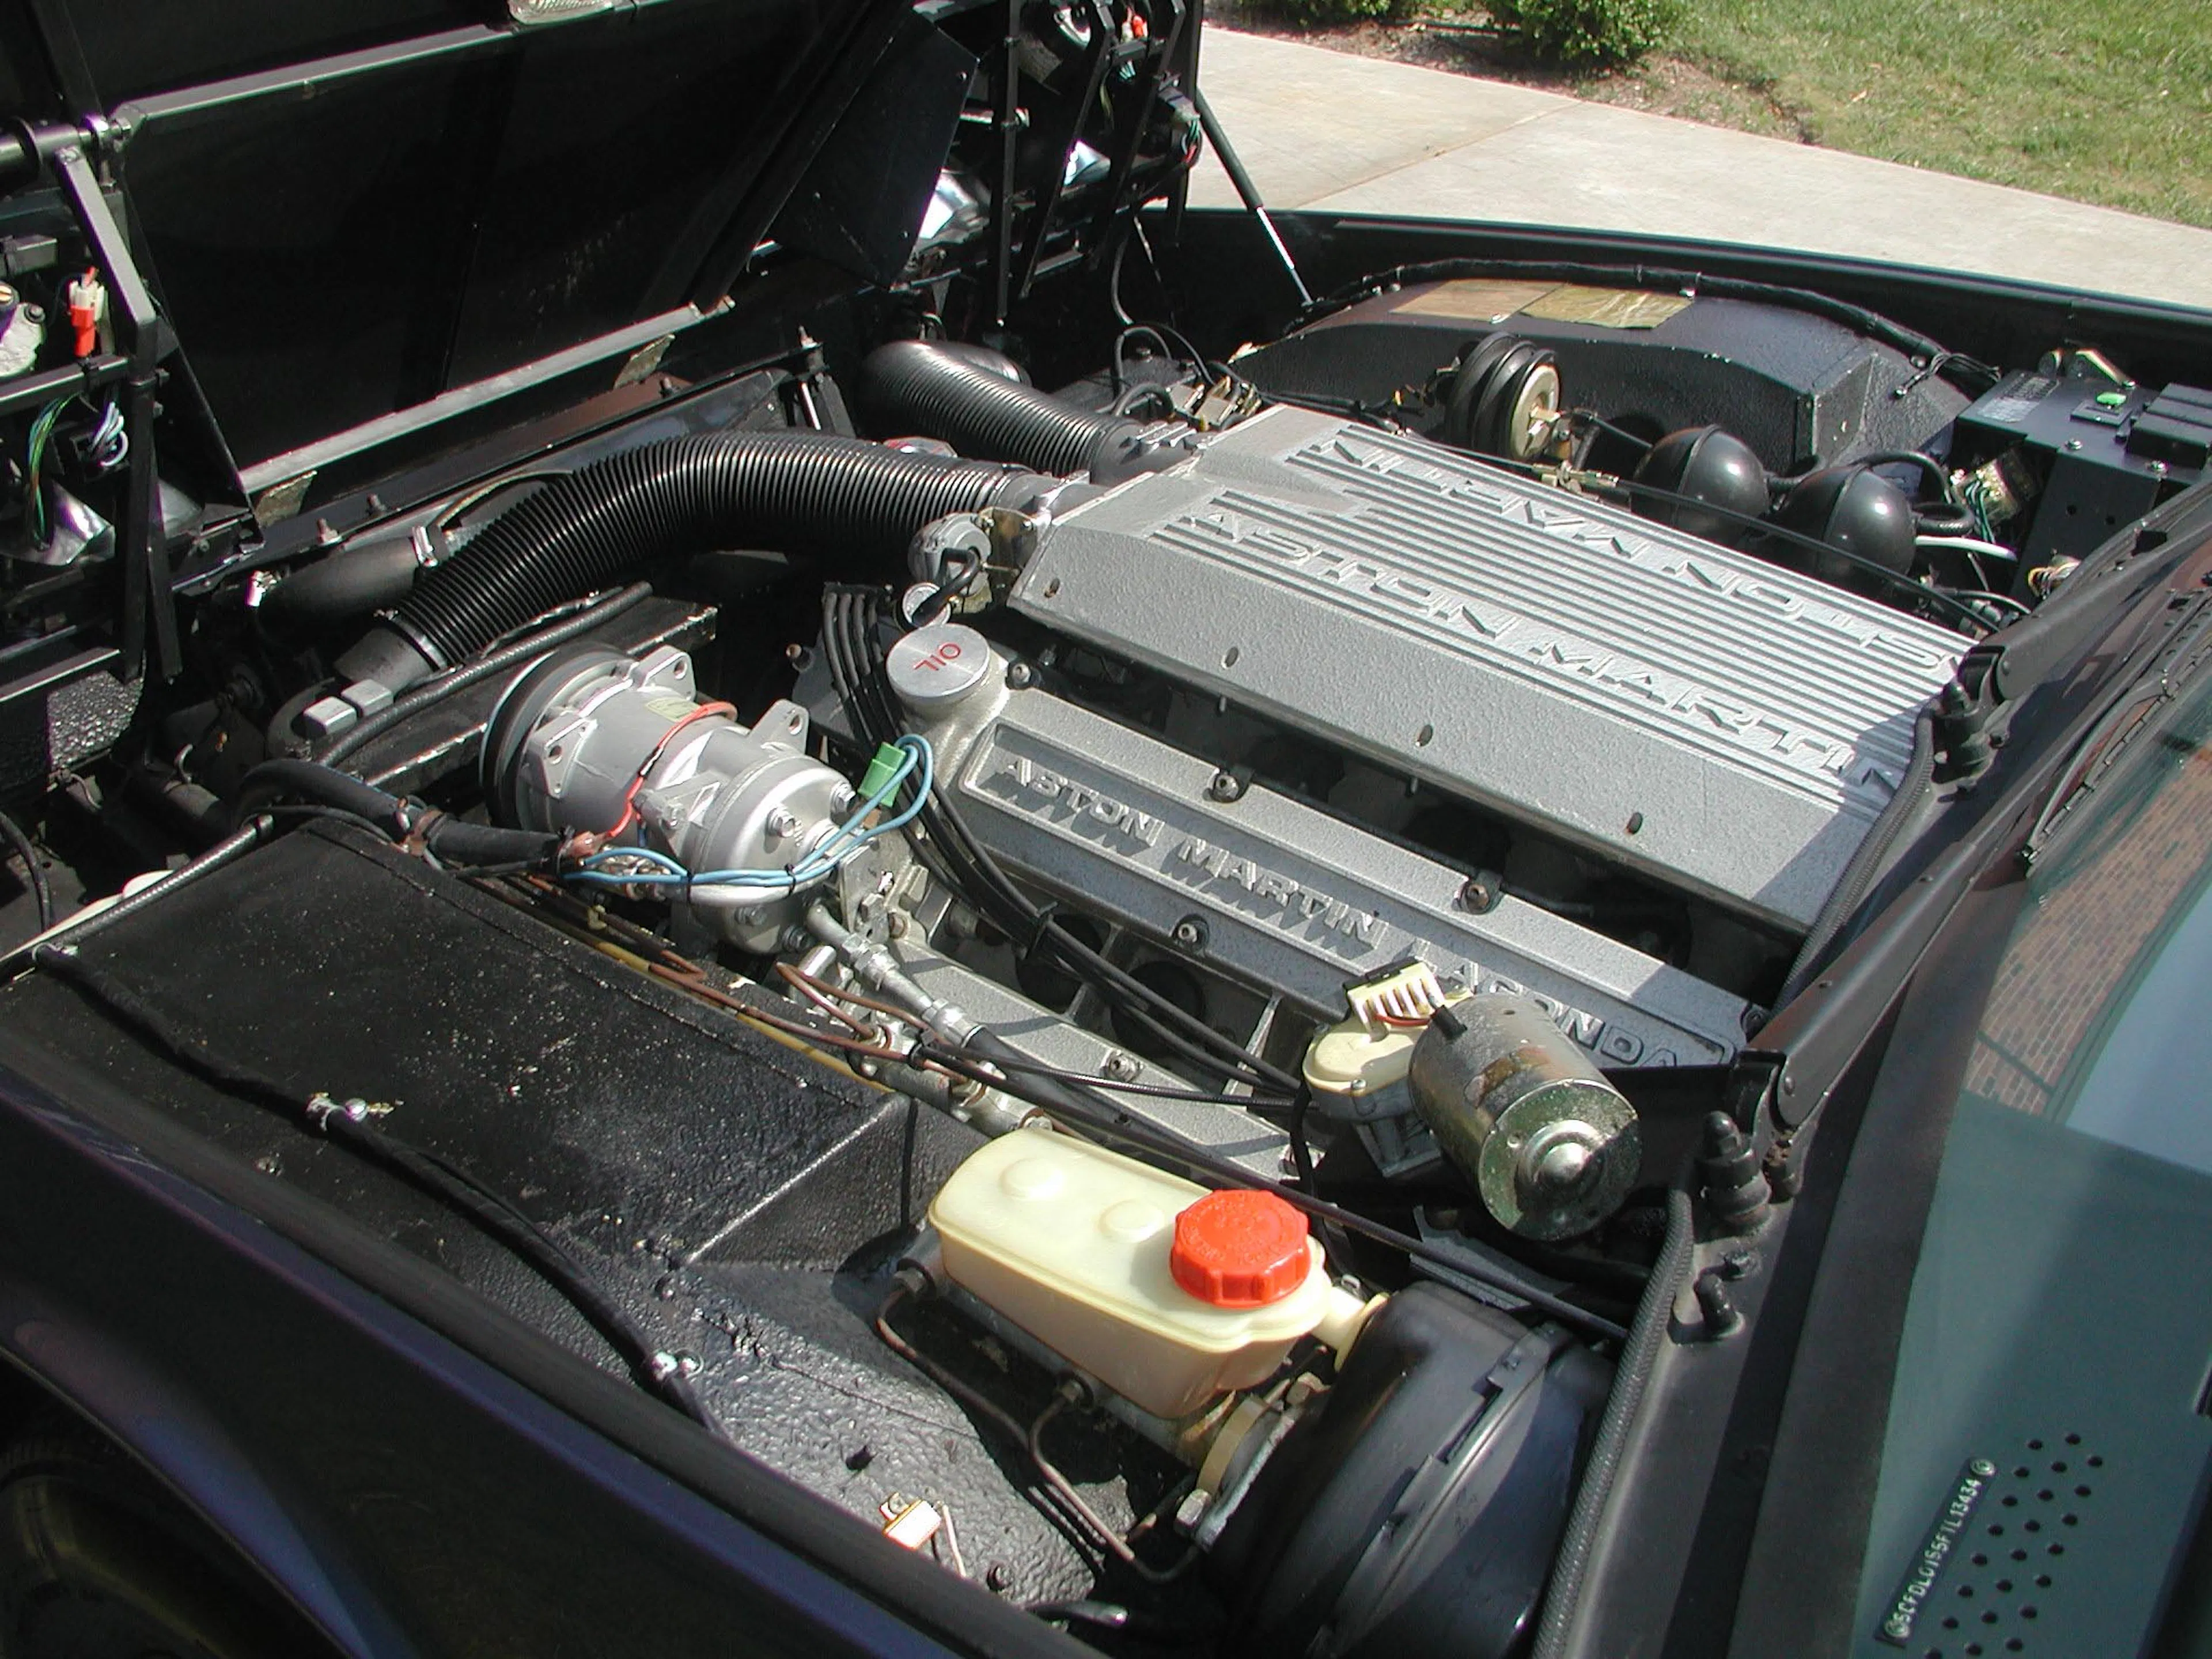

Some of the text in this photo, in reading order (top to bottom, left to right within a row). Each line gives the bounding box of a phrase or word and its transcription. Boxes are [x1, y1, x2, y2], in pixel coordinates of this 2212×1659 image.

[1309, 438, 1651, 560] MARTIN
[1178, 512, 1523, 639] ASTON
[912, 642, 962, 671] OIL
[1001, 756, 1165, 847] ASTON
[1178, 836, 1390, 950] MARTIN
